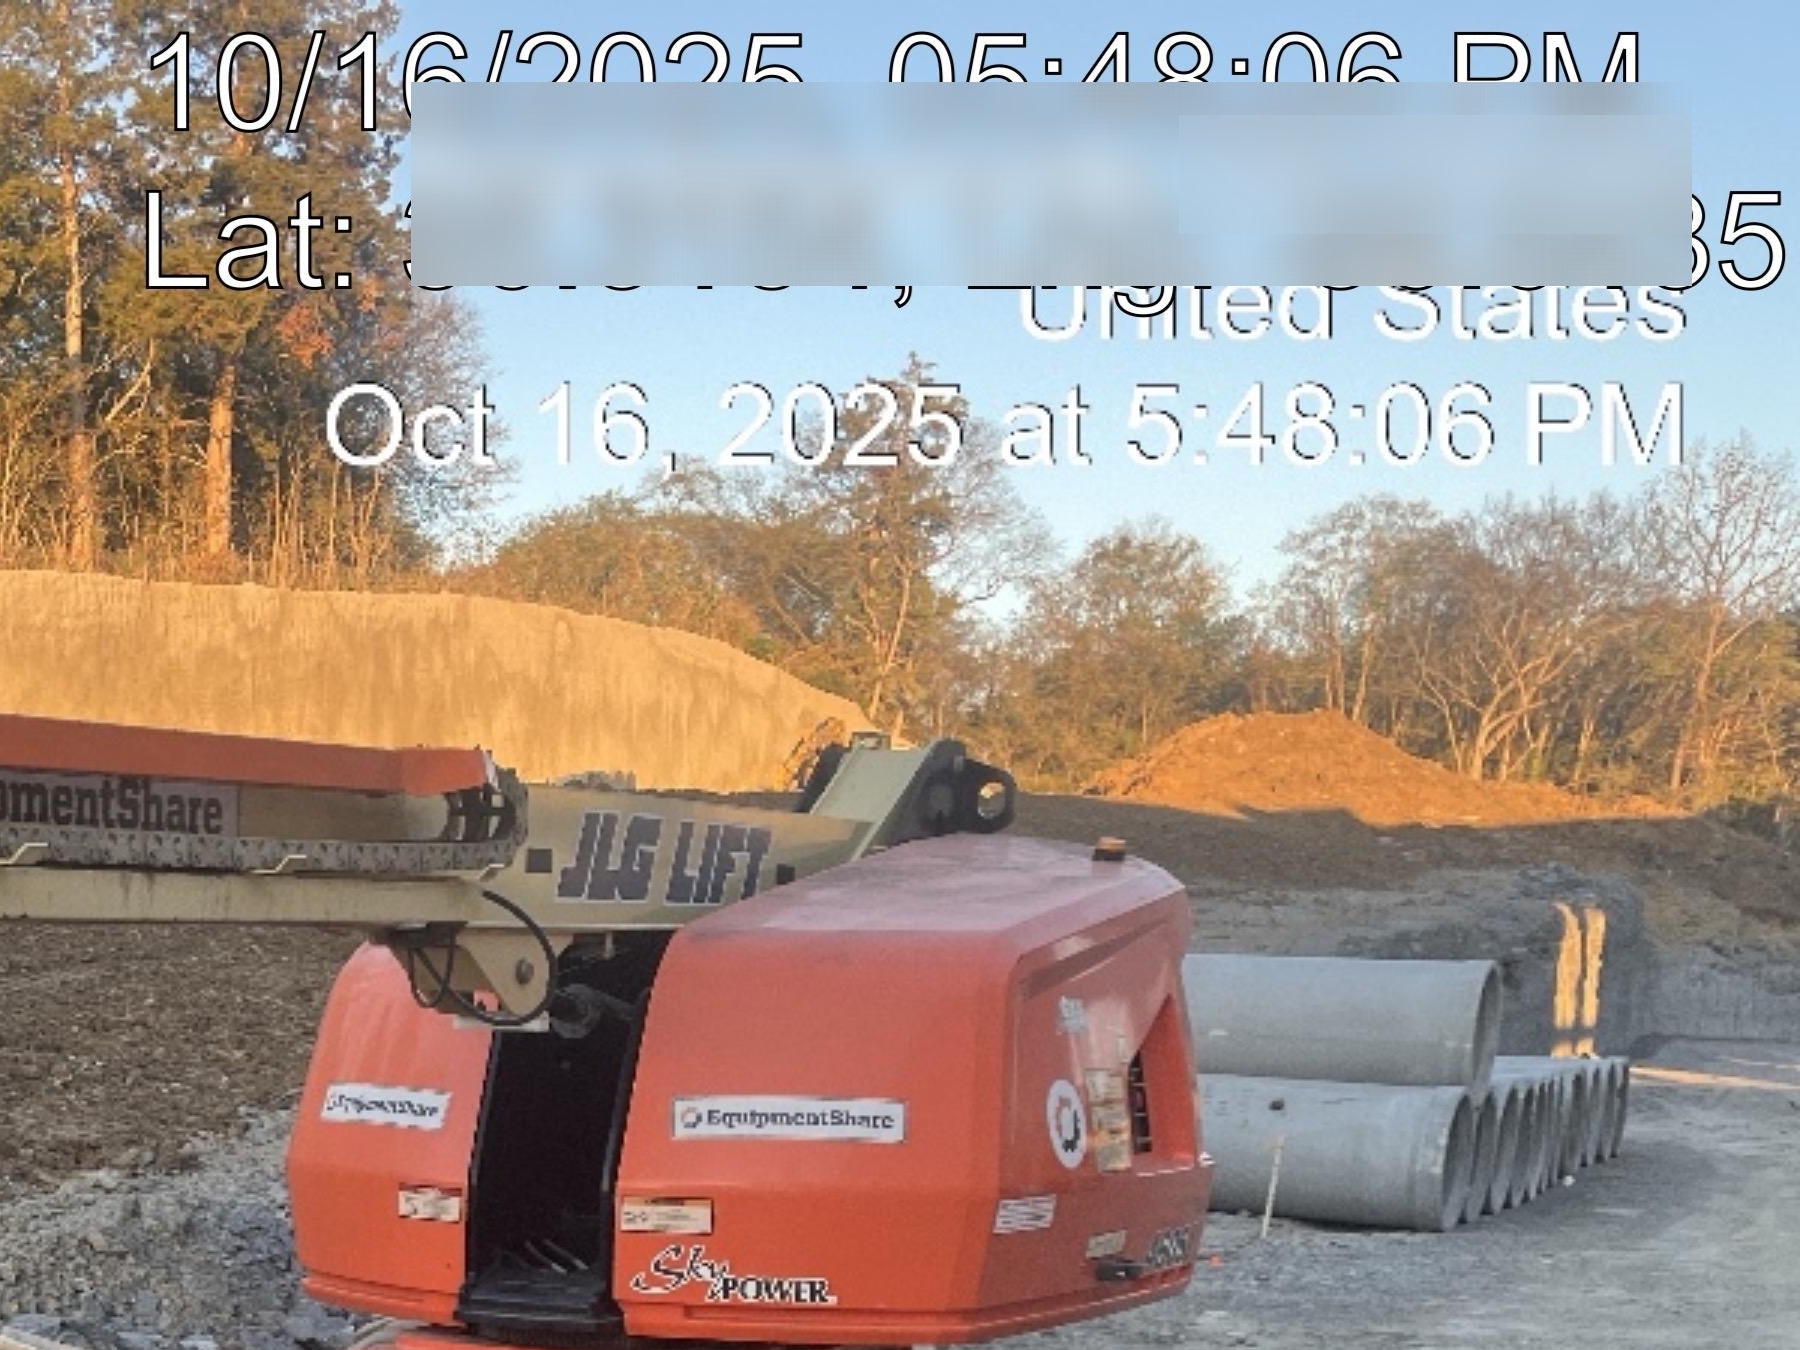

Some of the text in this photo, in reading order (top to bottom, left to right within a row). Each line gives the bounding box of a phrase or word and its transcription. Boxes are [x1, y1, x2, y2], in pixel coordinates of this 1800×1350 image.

[556, 810, 773, 906] JLG LIFT
[706, 1108, 896, 1129] EquipmentShare
[718, 1277, 834, 1304] POWER
